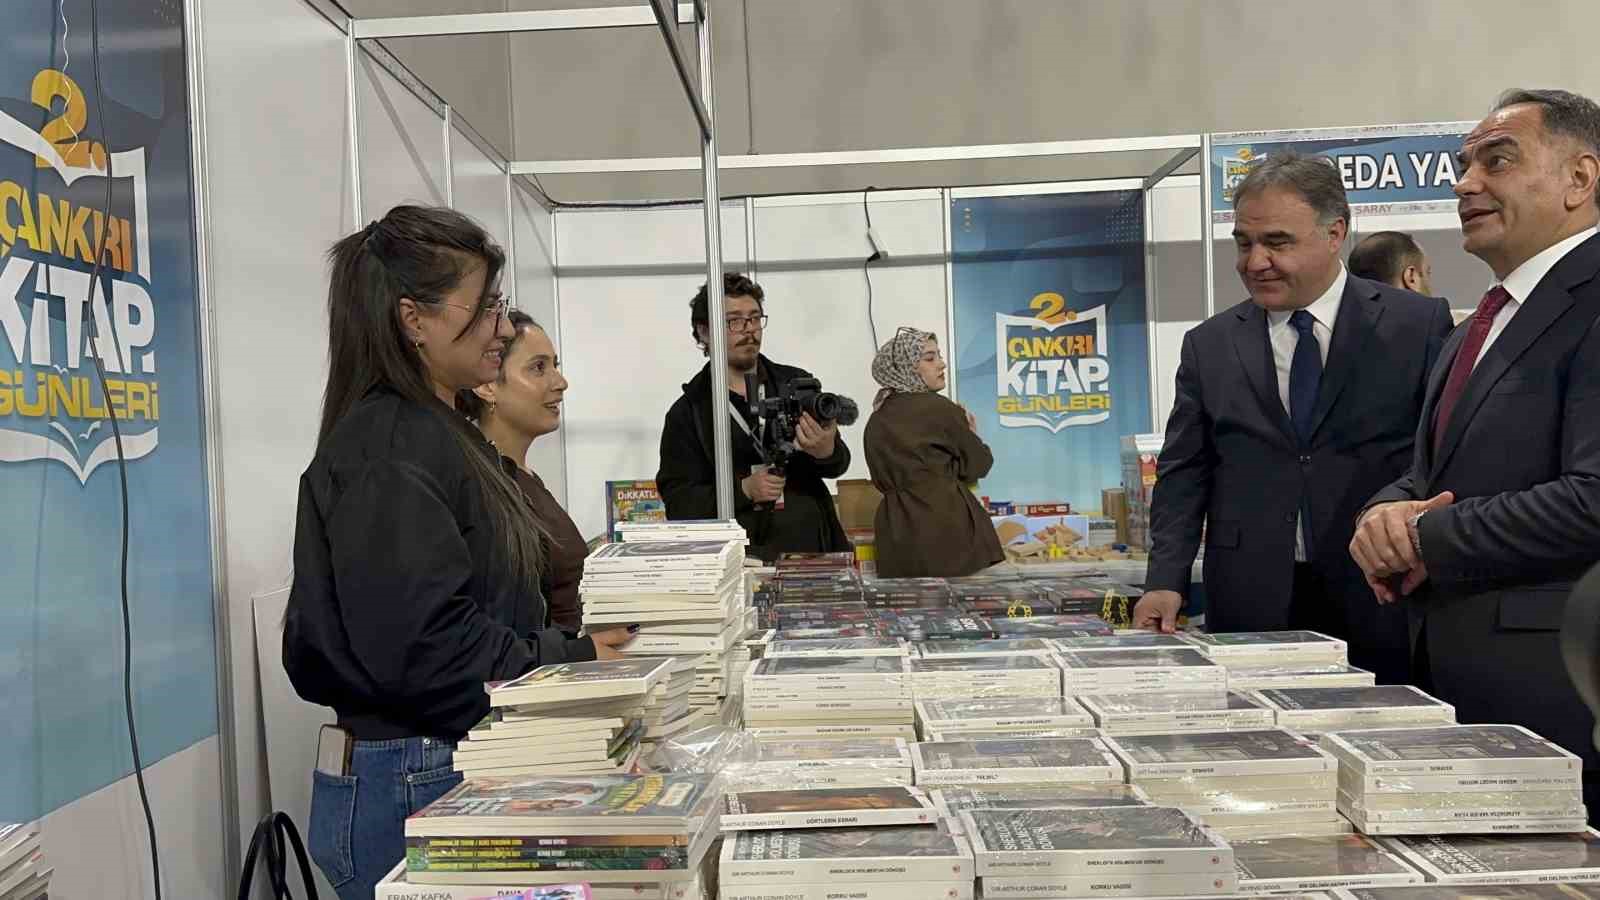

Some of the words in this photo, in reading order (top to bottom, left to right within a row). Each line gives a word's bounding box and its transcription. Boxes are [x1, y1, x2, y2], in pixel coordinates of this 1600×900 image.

[31, 68, 109, 171] 2.
[1326, 152, 1404, 190] EDA
[1408, 149, 1461, 187] YA
[1354, 204, 1393, 215] SARAY
[1029, 292, 1078, 325] 2.
[1007, 335, 1094, 358] ÇANKIRI
[0, 368, 159, 421] GÜNLERİ
[996, 393, 1111, 414] GÜNLERİ
[420, 892, 453, 900] KAFKA
